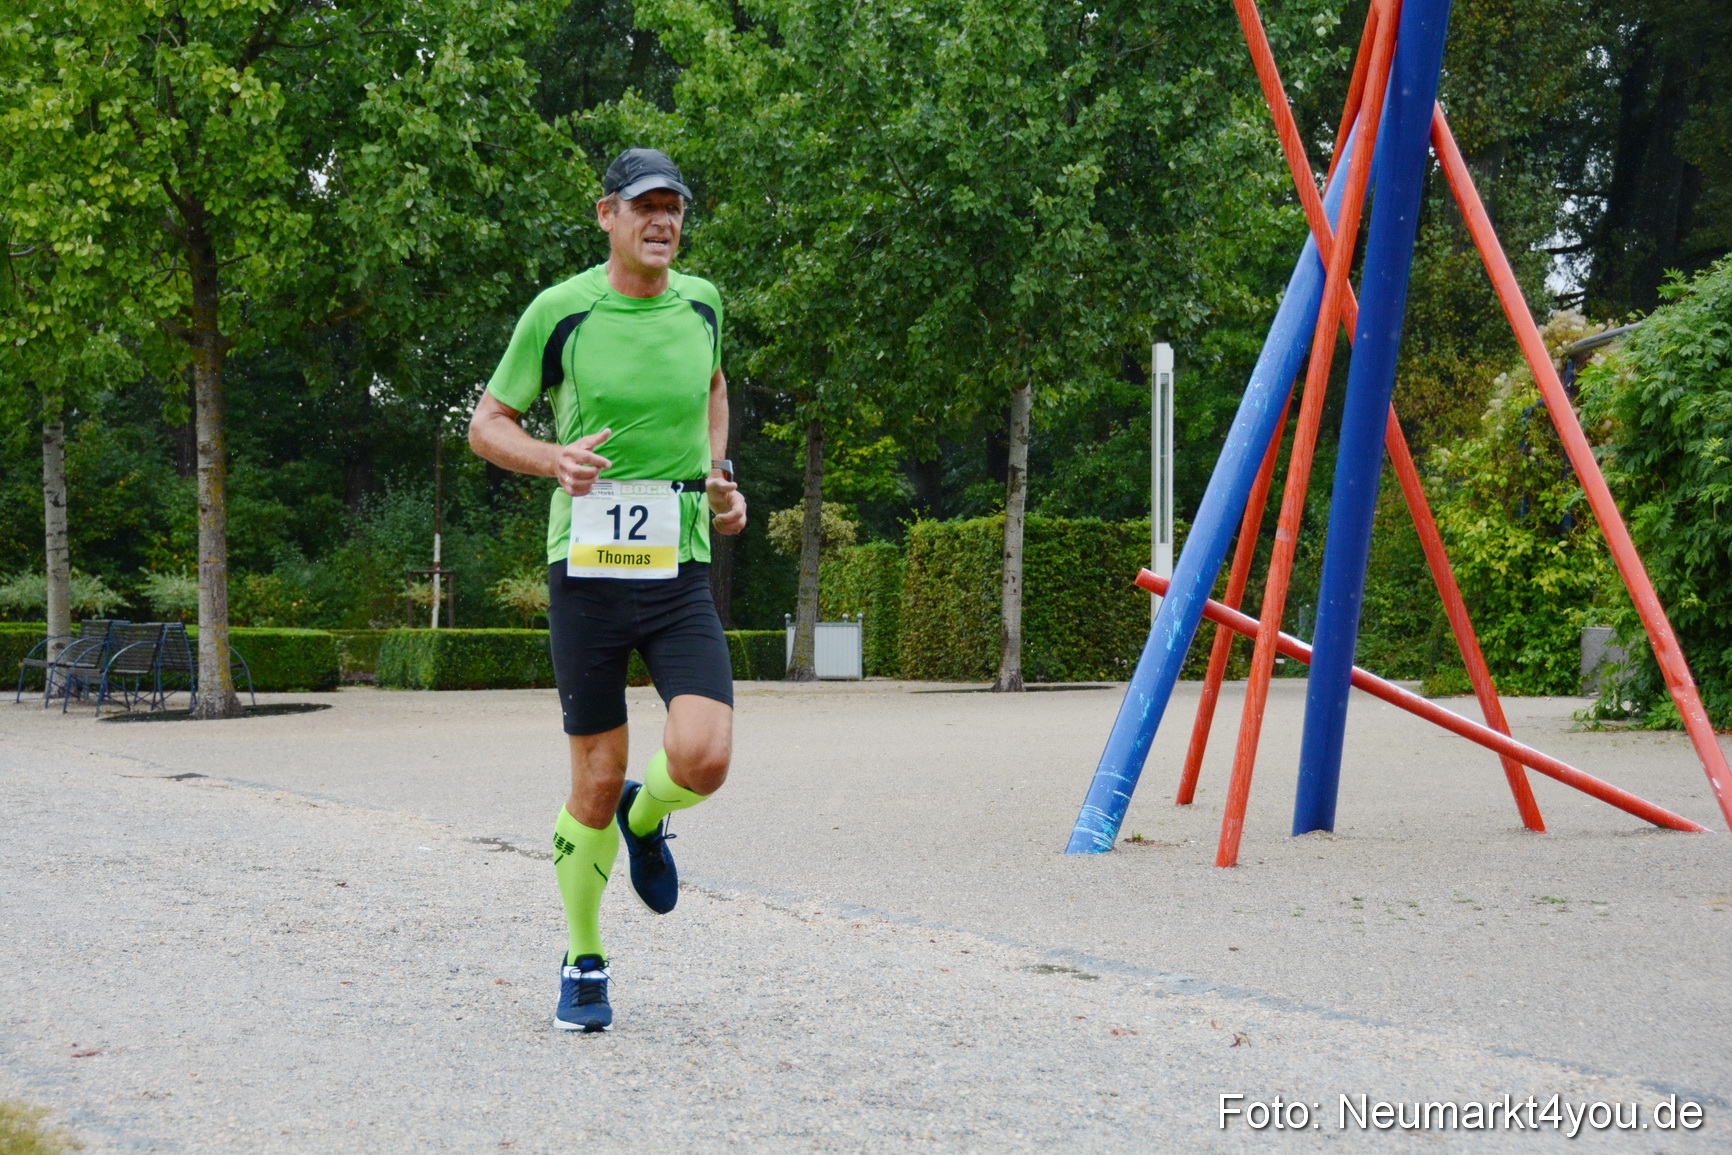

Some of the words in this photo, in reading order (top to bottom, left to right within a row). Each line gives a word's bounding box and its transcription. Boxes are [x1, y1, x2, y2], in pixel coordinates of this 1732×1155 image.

[621, 483, 670, 496] BOCK
[606, 504, 649, 541] 12
[596, 549, 651, 566] Thomas
